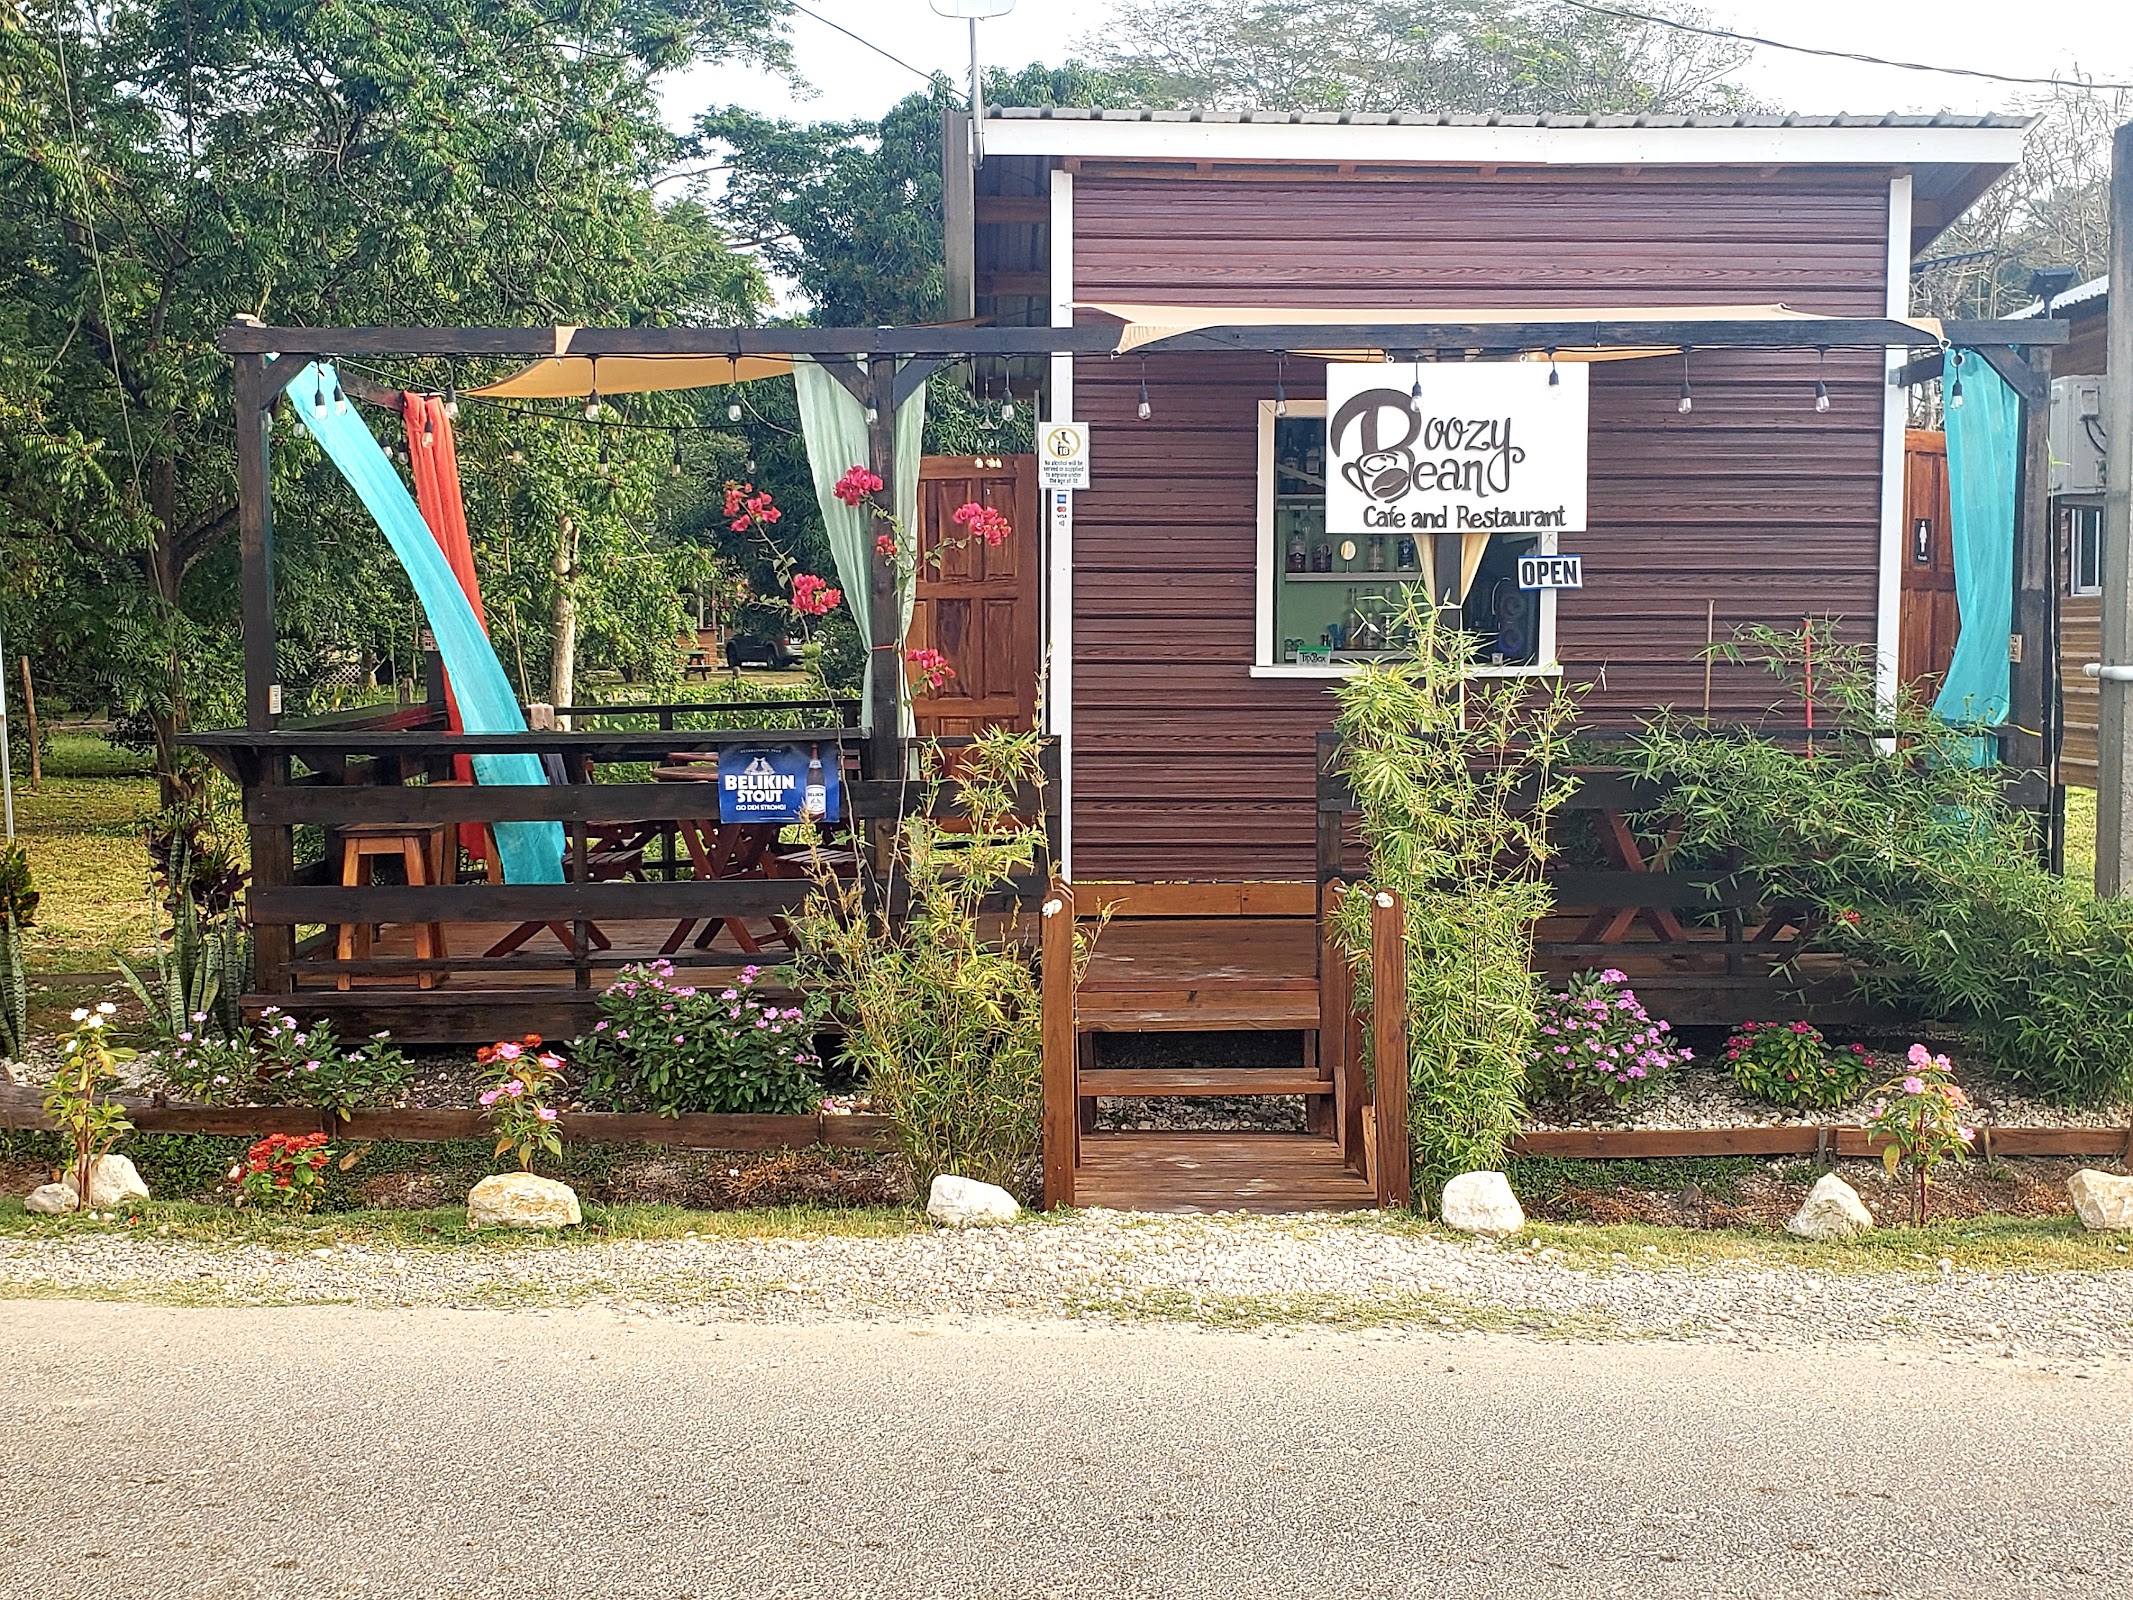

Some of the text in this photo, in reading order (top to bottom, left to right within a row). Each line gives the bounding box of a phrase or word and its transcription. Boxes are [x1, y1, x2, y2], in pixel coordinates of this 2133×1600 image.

[1059, 447, 1069, 455] 18
[1330, 388, 1526, 494] Boozy
[1341, 449, 1489, 504] Bean
[1363, 505, 1567, 528] Cafe and Restaurant
[1521, 560, 1578, 586] OPEN
[724, 774, 795, 790] BELIKIN
[737, 790, 783, 803] STOUT
